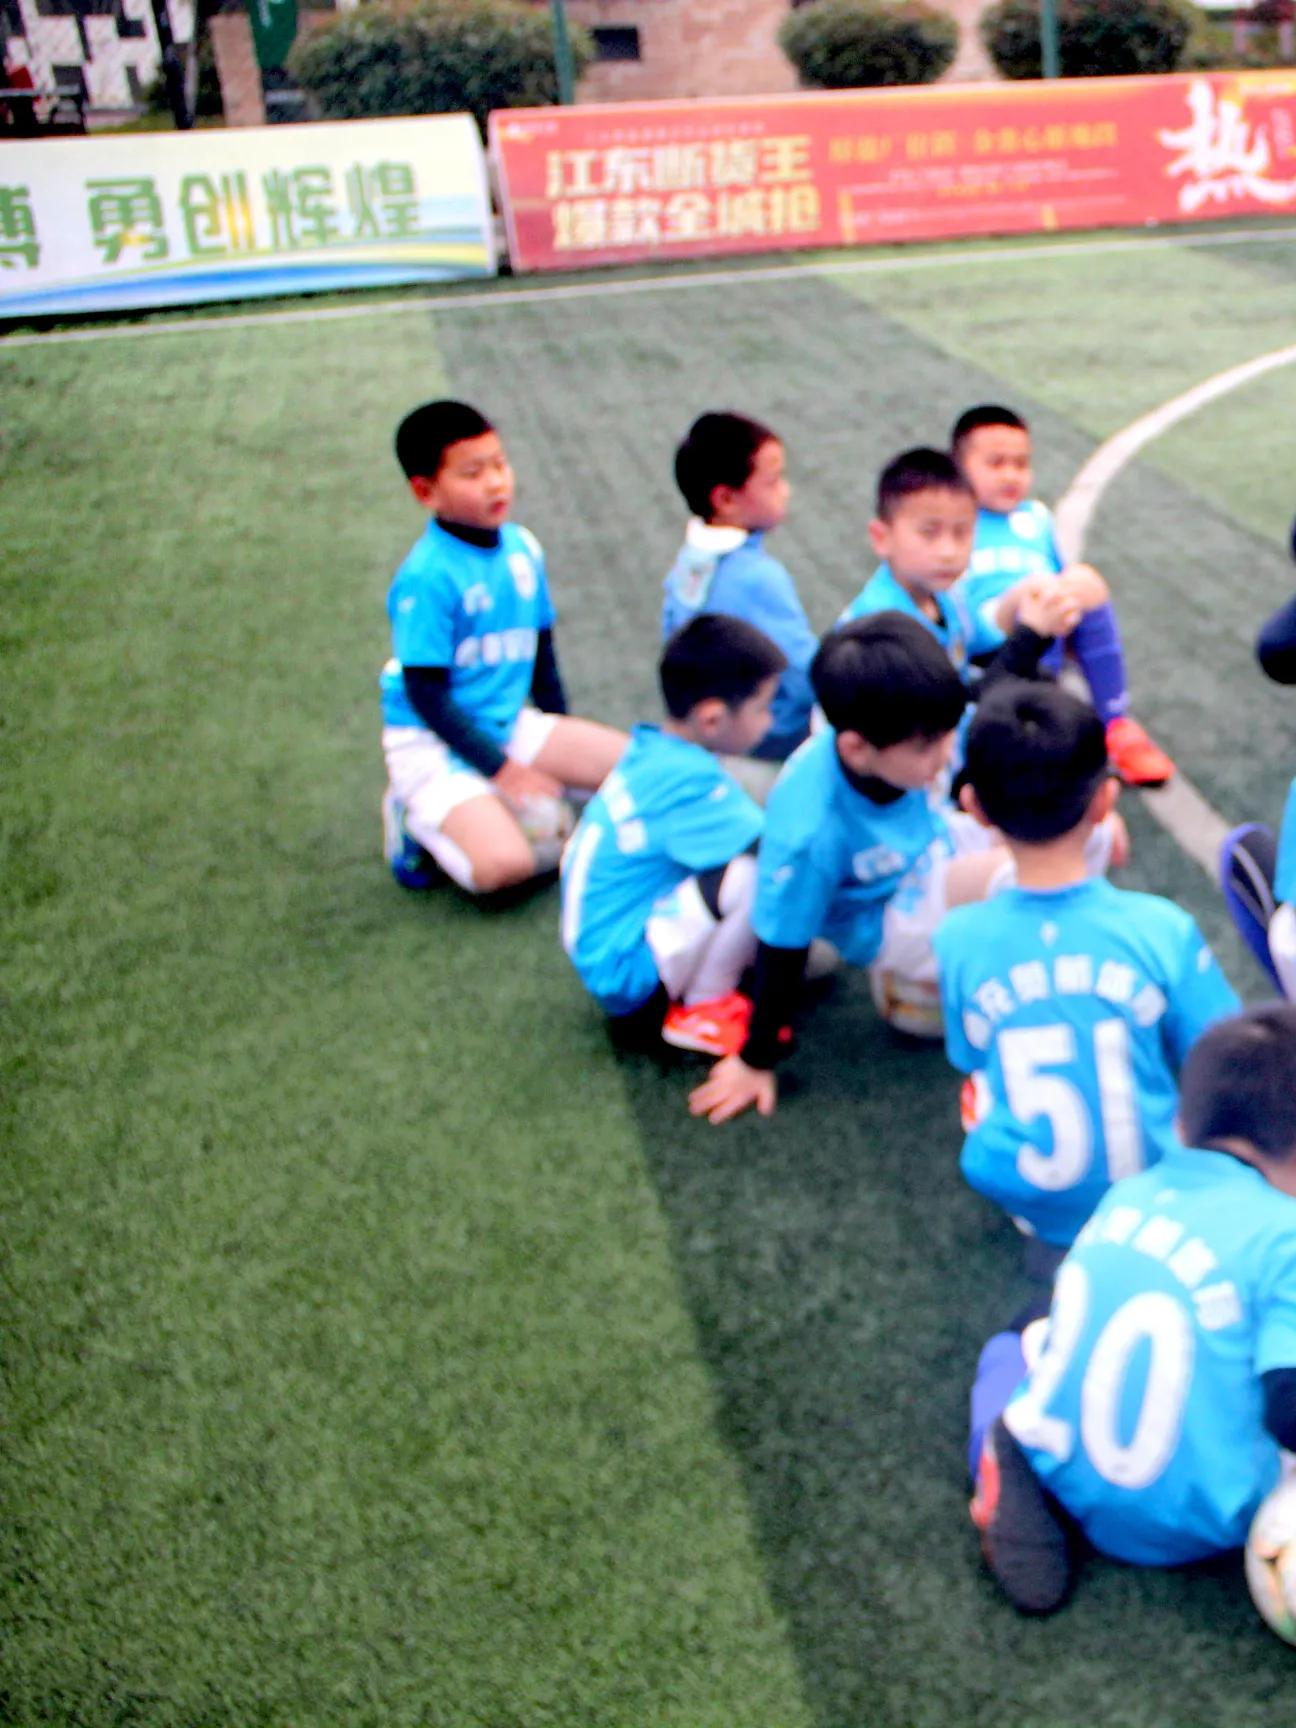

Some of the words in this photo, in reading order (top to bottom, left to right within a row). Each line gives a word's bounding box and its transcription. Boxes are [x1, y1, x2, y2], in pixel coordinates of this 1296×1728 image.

[85, 160, 420, 263] 勇创辉煌
[997, 1017, 1146, 1192] 51
[1003, 1261, 1195, 1490] 20
